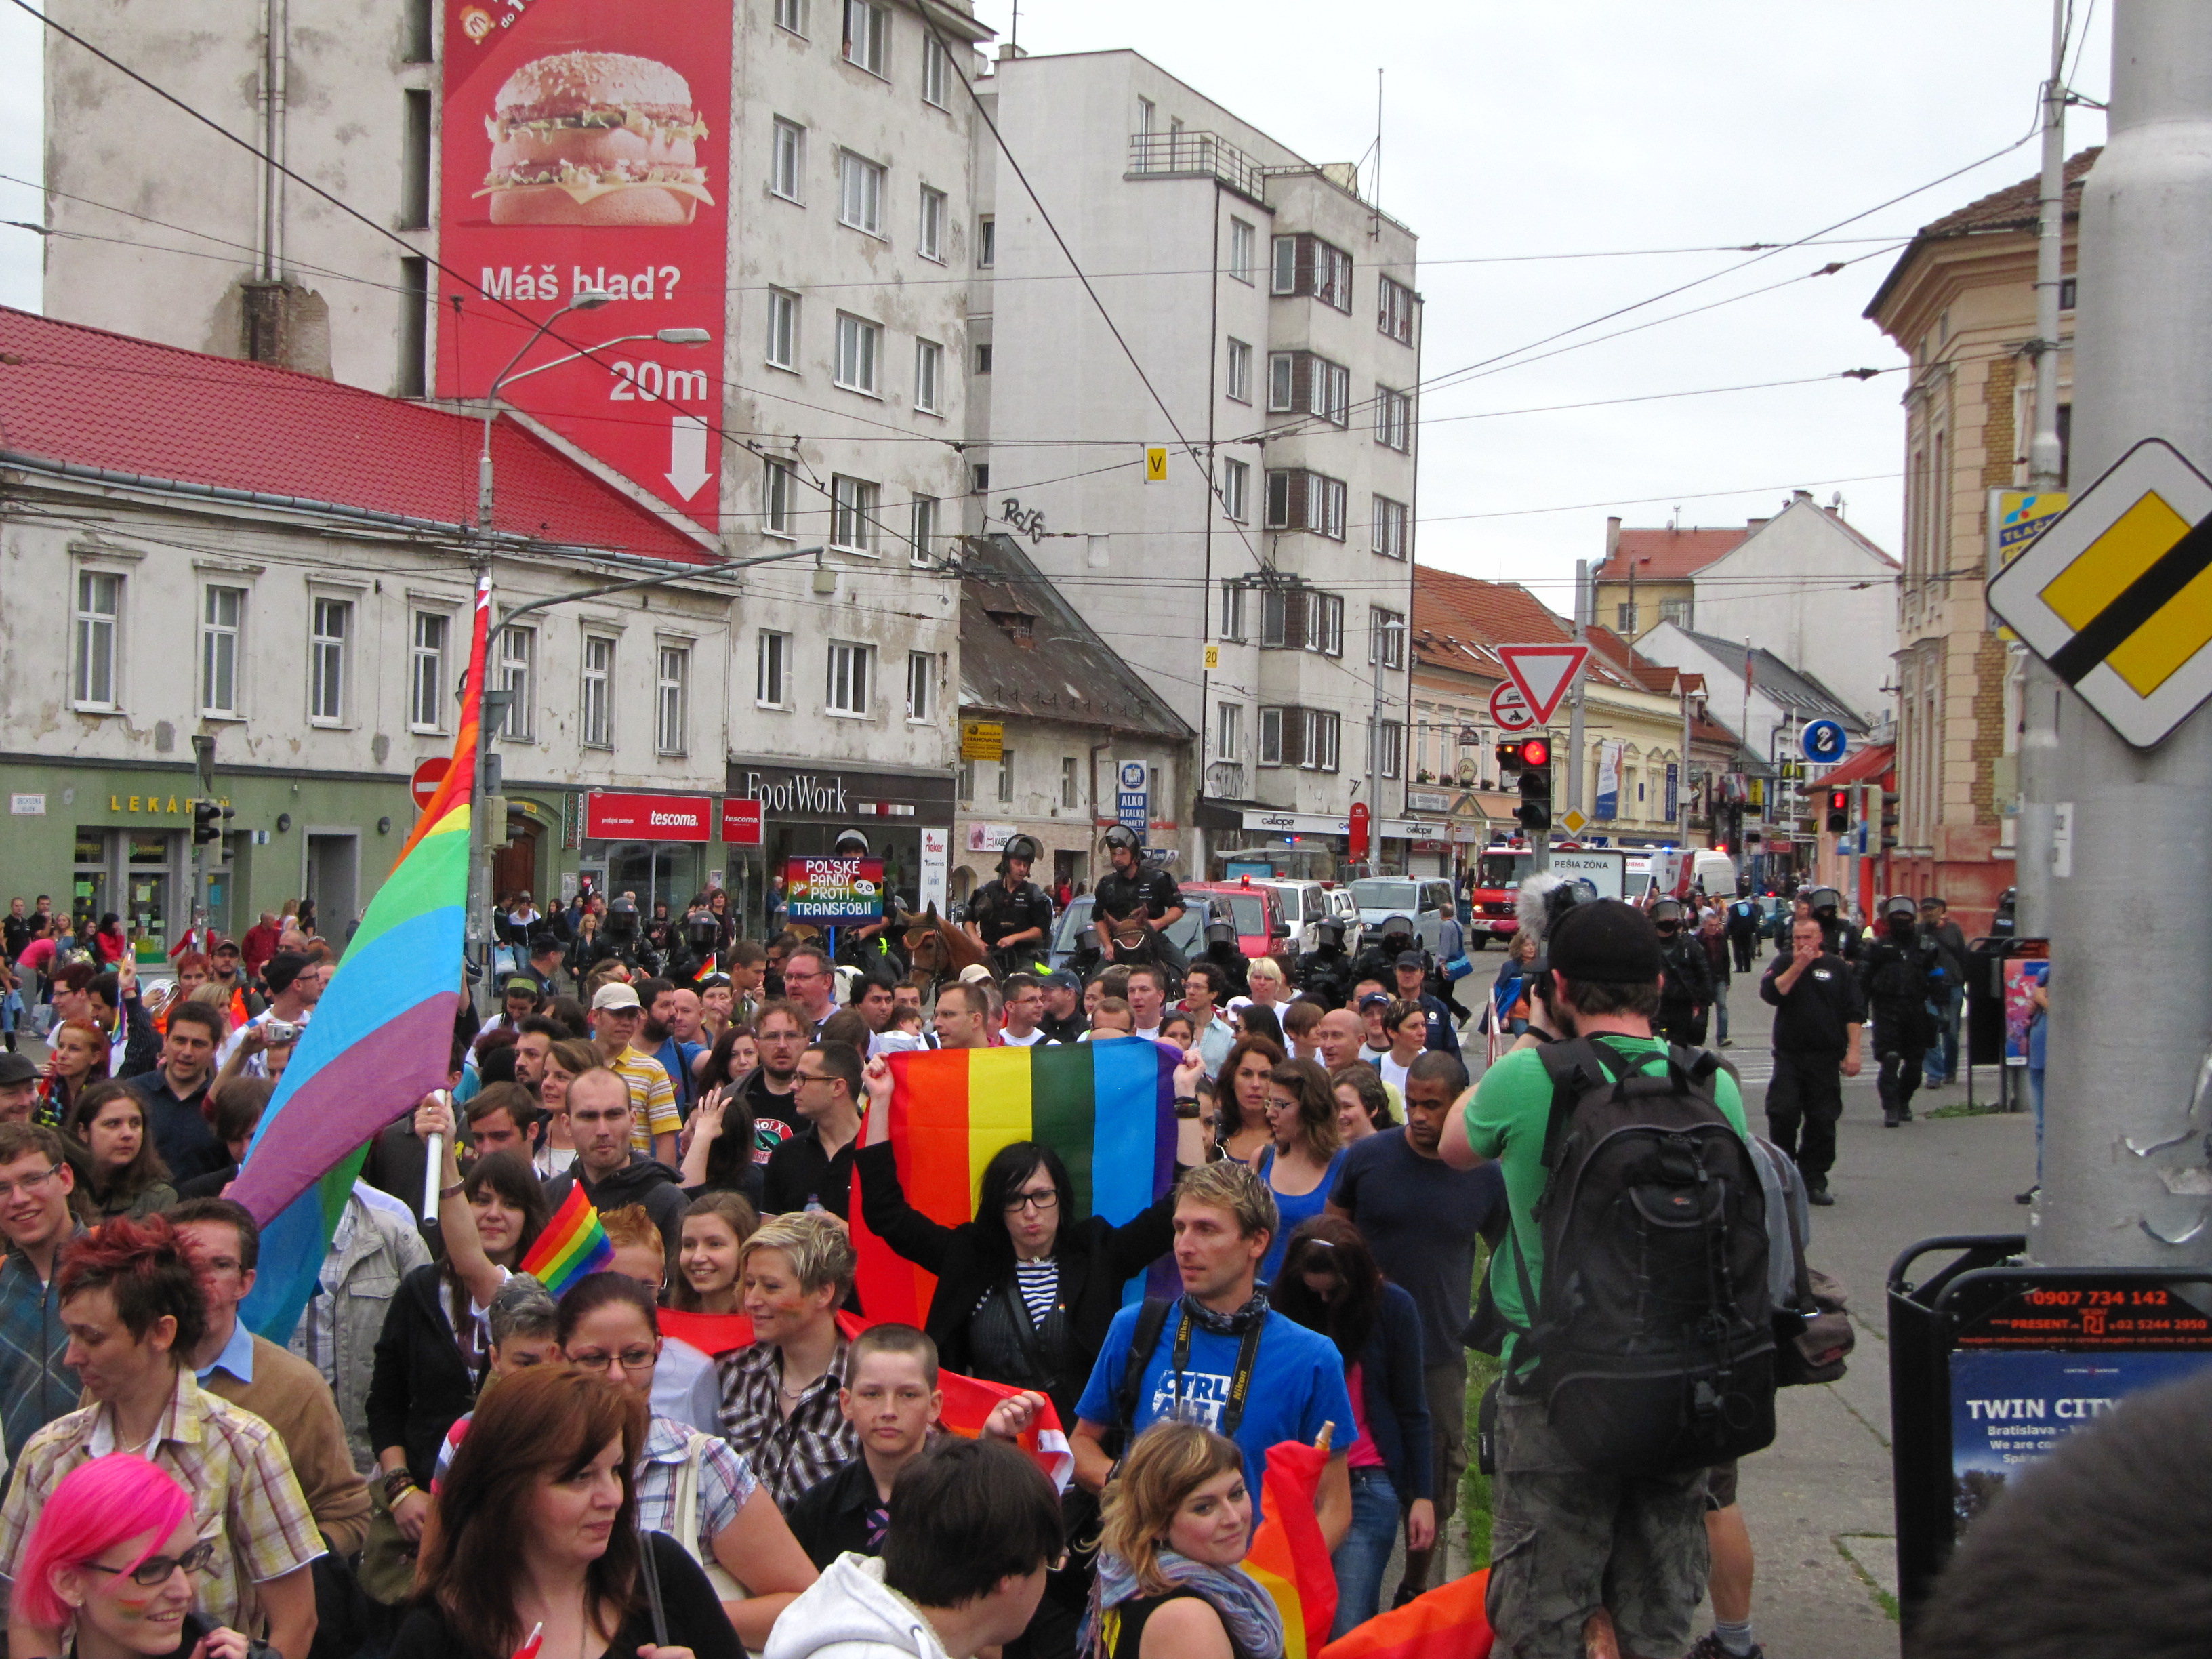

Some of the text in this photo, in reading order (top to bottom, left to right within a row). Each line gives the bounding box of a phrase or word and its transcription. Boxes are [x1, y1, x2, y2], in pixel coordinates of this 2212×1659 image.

[482, 265, 681, 301] Máš hlad?
[610, 361, 708, 401] 20m
[1151, 456, 1163, 472] V
[1206, 651, 1217, 663] 20
[746, 771, 847, 813] FootWork
[1121, 795, 1143, 806] ALKO
[651, 810, 699, 826] tescoma.
[725, 815, 759, 823] tescoma.
[1120, 808, 1145, 818] NEALKO
[806, 857, 861, 874] POĽSKÉ
[924, 859, 945, 867] Tamaris
[1554, 859, 1609, 869] PEŠIA ZÓNA
[810, 874, 851, 887] PANDY
[811, 887, 850, 900] PROTI
[794, 898, 872, 916] TRANSFÓBII
[2033, 1290, 2168, 1305] 0907 734 142
[2011, 1319, 2070, 1330] PRESENT
[1159, 1373, 1230, 1403] CTRL
[1232, 1370, 1248, 1400] Nikon
[1965, 1398, 2046, 1419] TWIN
[1987, 1425, 2055, 1436] Bratislava
[1990, 1440, 2010, 1450] We
[2013, 1441, 2034, 1450] are
